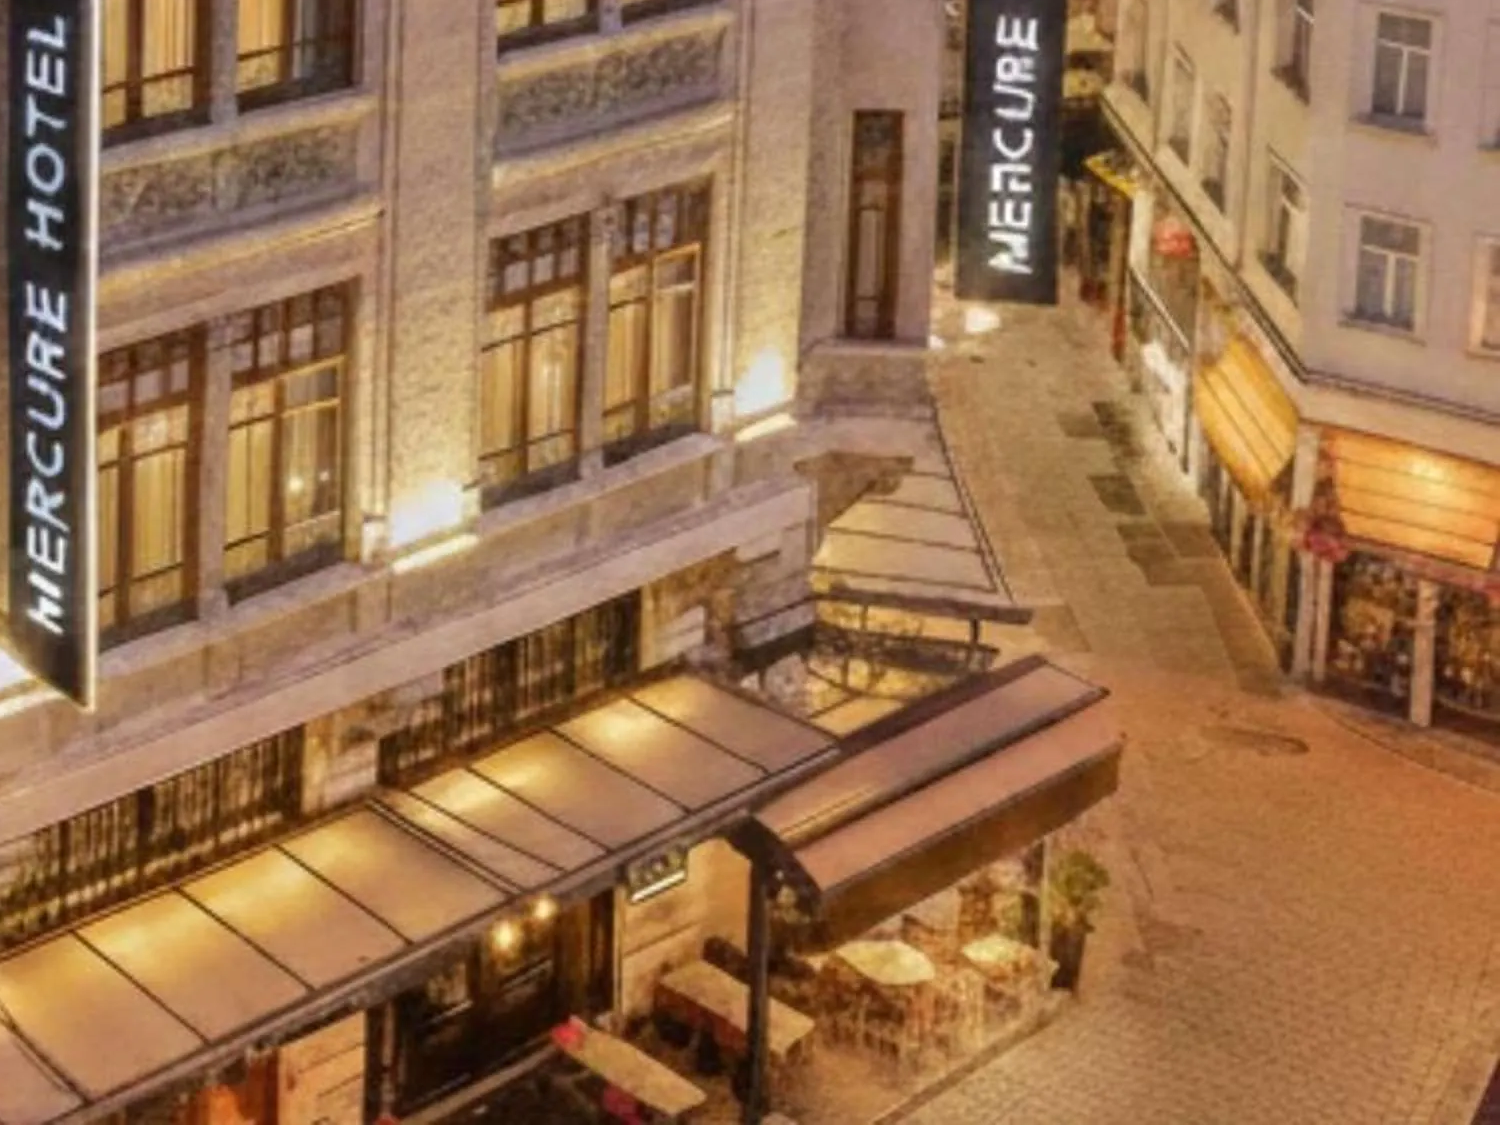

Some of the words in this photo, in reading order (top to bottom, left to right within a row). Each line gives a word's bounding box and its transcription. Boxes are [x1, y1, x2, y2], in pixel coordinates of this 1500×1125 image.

[25, 15, 66, 249] HOTEL
[987, 14, 1038, 274] MERCURE
[25, 282, 68, 635] MERCURE
